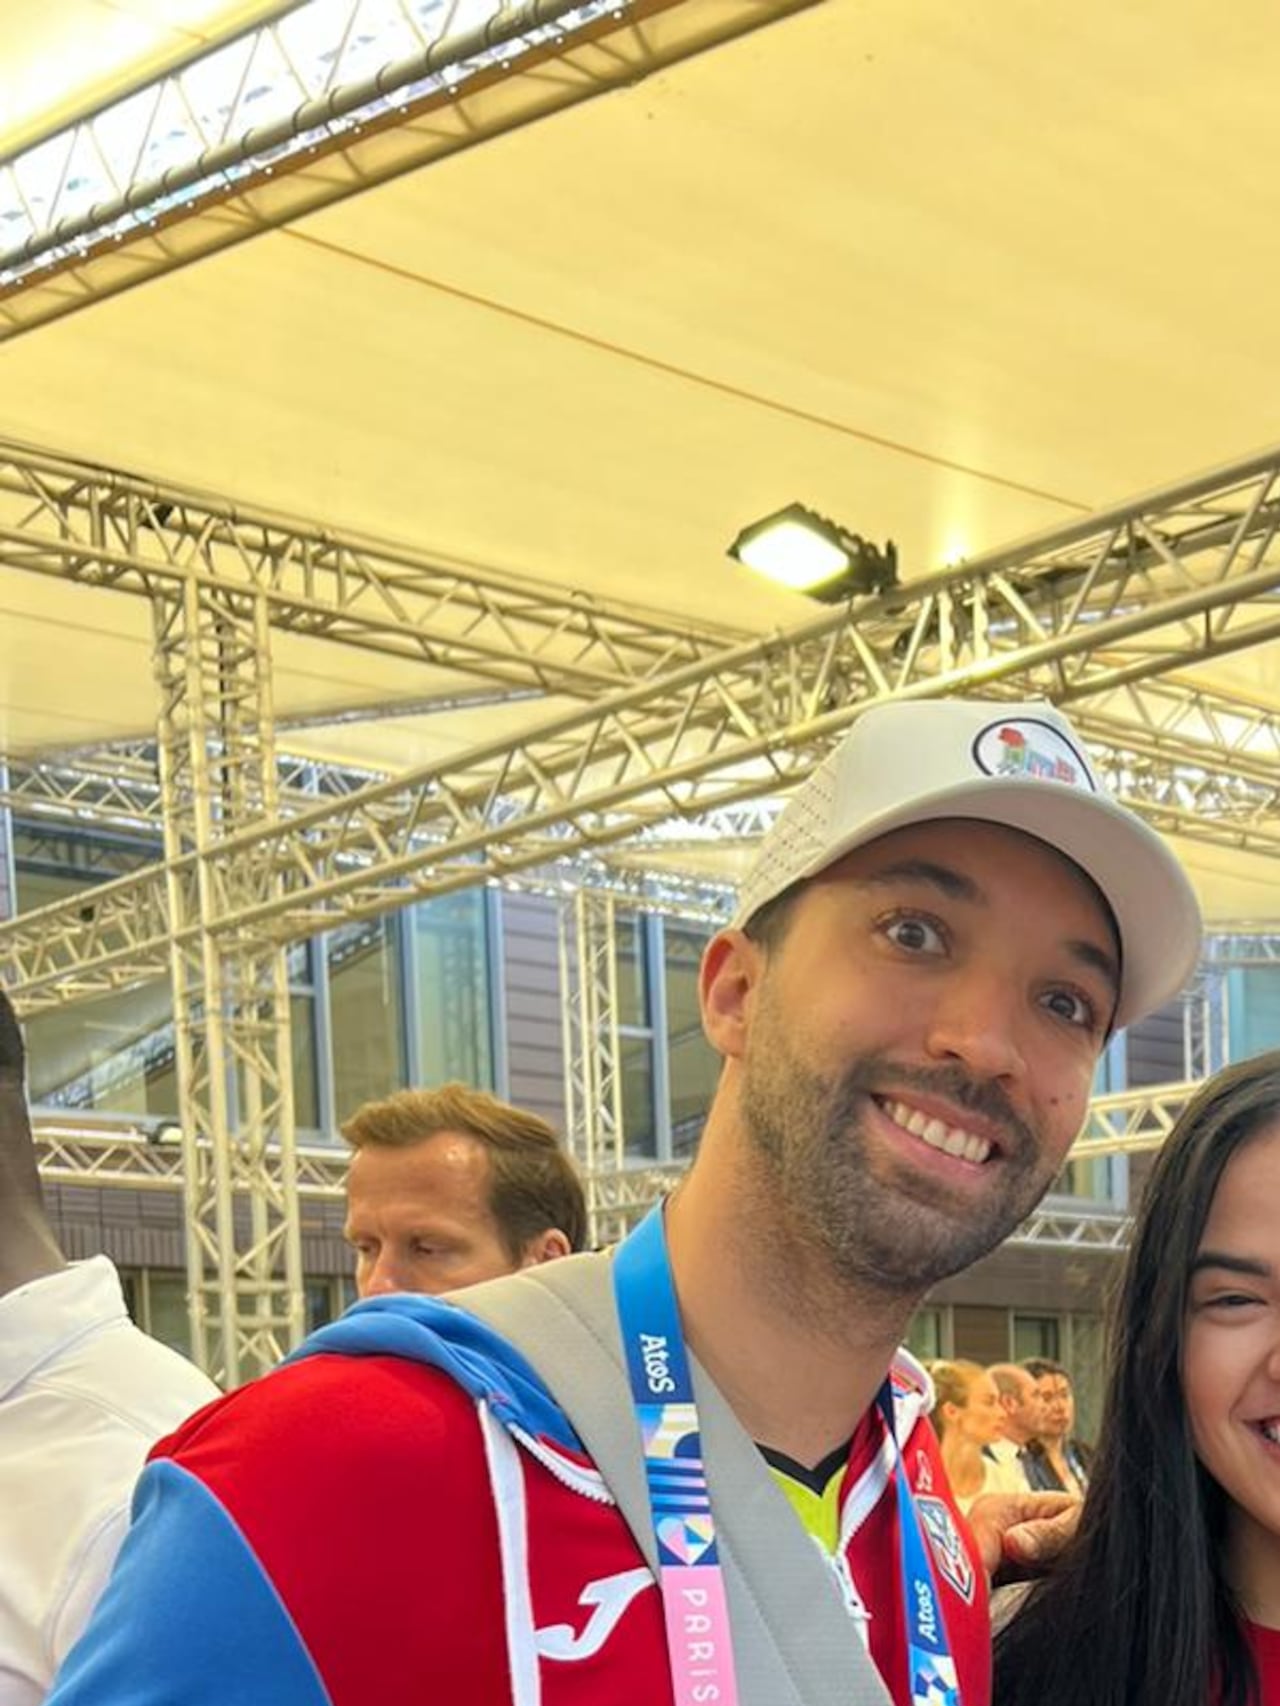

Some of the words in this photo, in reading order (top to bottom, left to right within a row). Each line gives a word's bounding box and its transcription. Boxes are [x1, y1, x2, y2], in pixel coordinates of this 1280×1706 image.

[639, 1332, 676, 1394] Atos
[681, 1588, 721, 1702] PARIS
[914, 1579, 939, 1645] Atos
